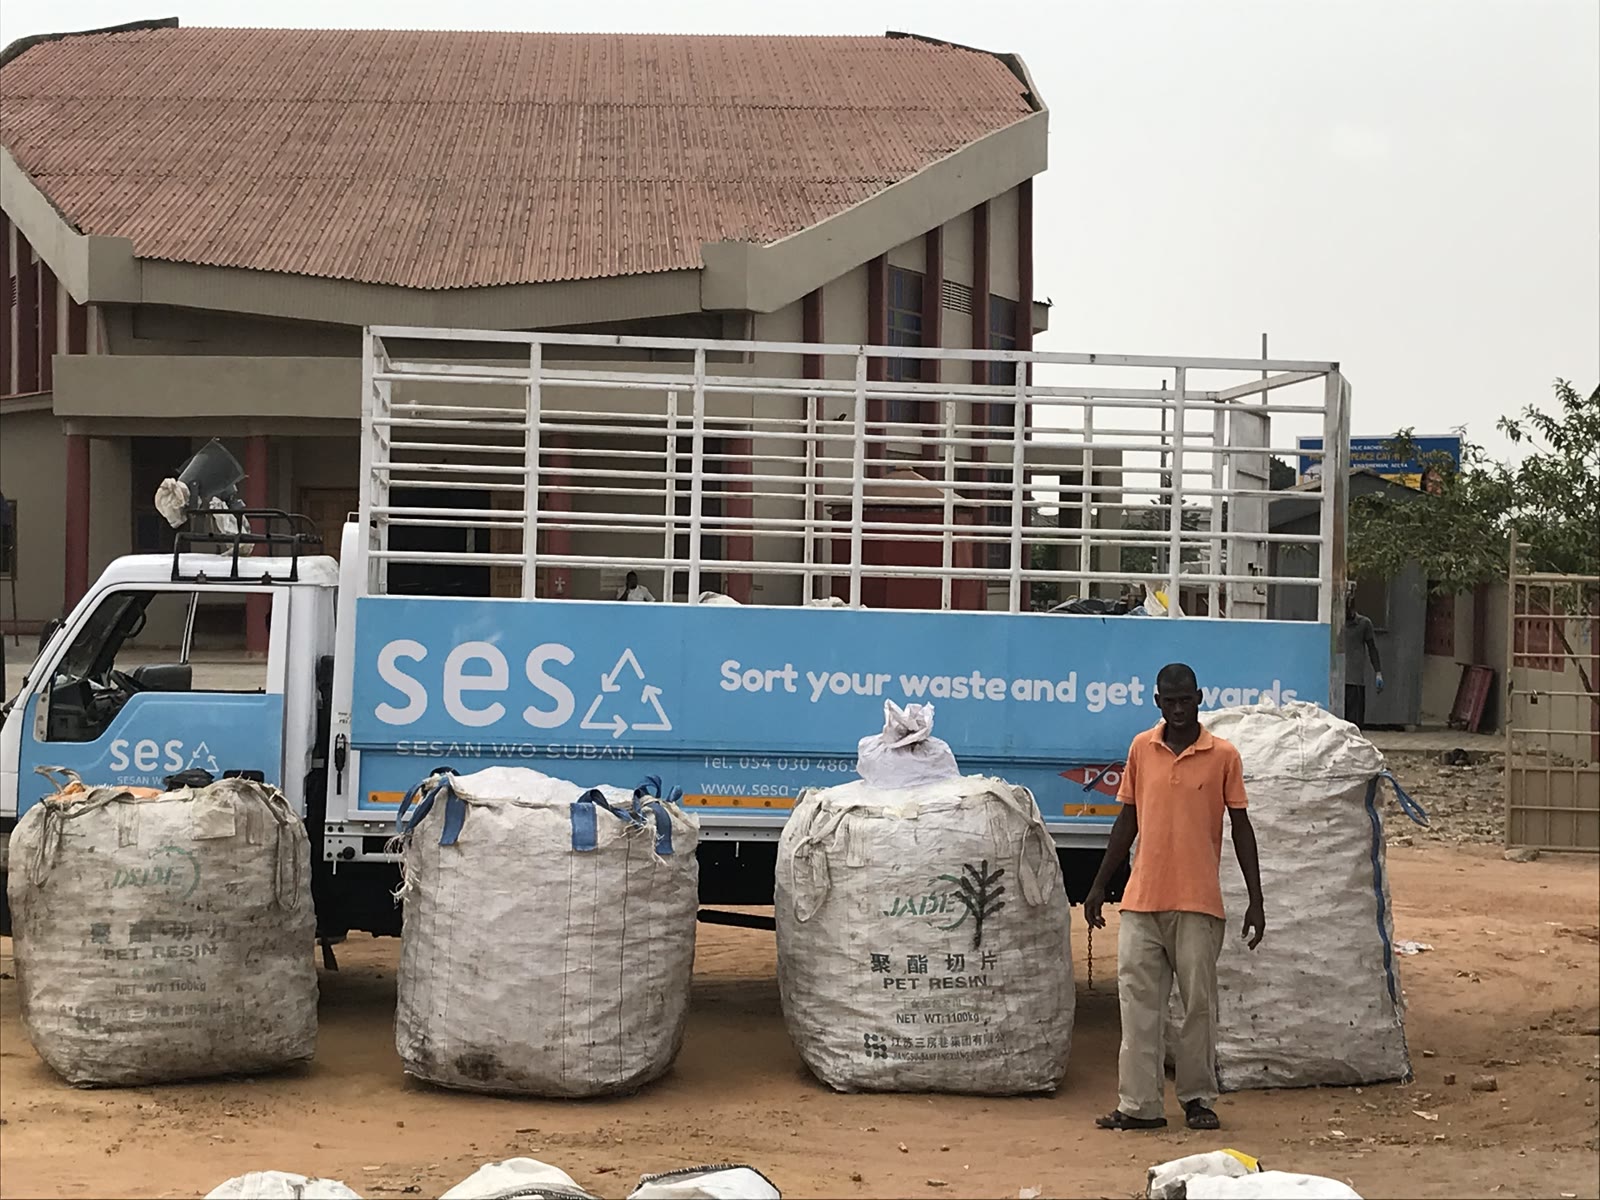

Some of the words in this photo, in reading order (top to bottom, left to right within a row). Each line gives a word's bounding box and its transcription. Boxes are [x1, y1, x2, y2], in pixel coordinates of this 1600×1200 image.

[719, 659, 799, 693] Sort
[806, 670, 892, 703] your
[899, 670, 1007, 700] waste
[1010, 671, 1077, 703] and
[1085, 675, 1145, 713] get
[396, 740, 482, 758] SESAN
[492, 742, 537, 758] WO
[545, 743, 634, 760] SUBAN
[739, 757, 771, 770] 054
[777, 757, 810, 772] 030
[117, 776, 149, 786] SESAN
[1083, 767, 1122, 787] Do
[882, 892, 956, 917] JADE
[103, 947, 142, 961] PET
[152, 943, 219, 959] RESIN
[870, 951, 998, 975] 聚酯切片
[115, 983, 137, 995] NET
[883, 977, 920, 990] PET
[929, 975, 987, 990] RESIN
[896, 1013, 917, 1024] NET
